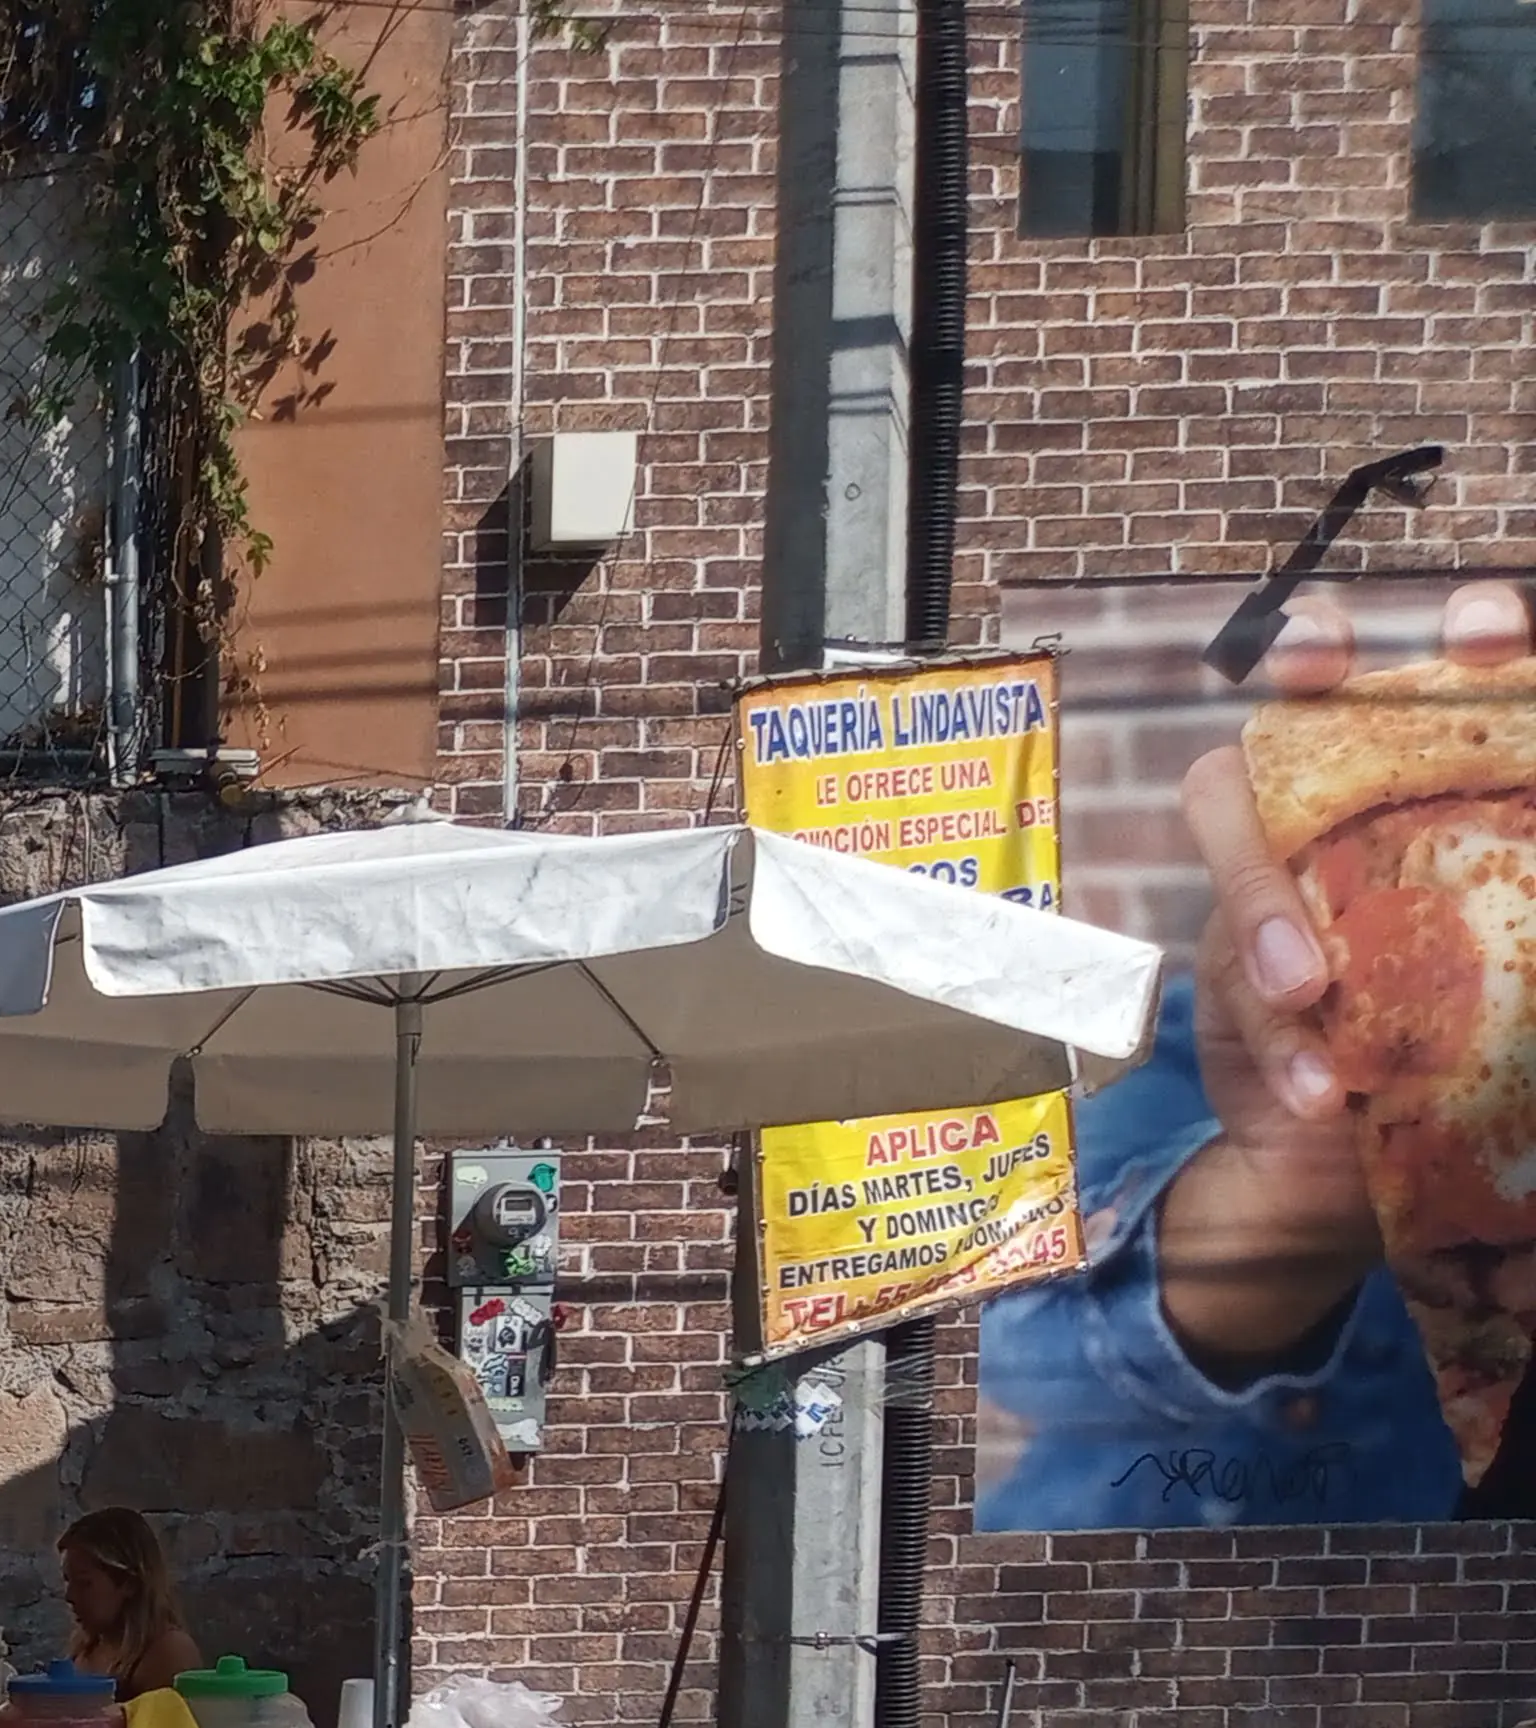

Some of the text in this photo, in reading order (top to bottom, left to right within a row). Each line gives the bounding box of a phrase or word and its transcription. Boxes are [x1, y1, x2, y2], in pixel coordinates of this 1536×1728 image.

[749, 682, 1046, 764] TAQUERÍA LINDAVISTA
[816, 760, 992, 805] LE OFRECE UNA
[899, 808, 1007, 847] ESPECIAL
[866, 1113, 1000, 1167] APLICA
[788, 1164, 973, 1217] DÍAS MARTES,
[857, 1218, 878, 1244] Y
[778, 1242, 948, 1289] ENTREGAMOS
